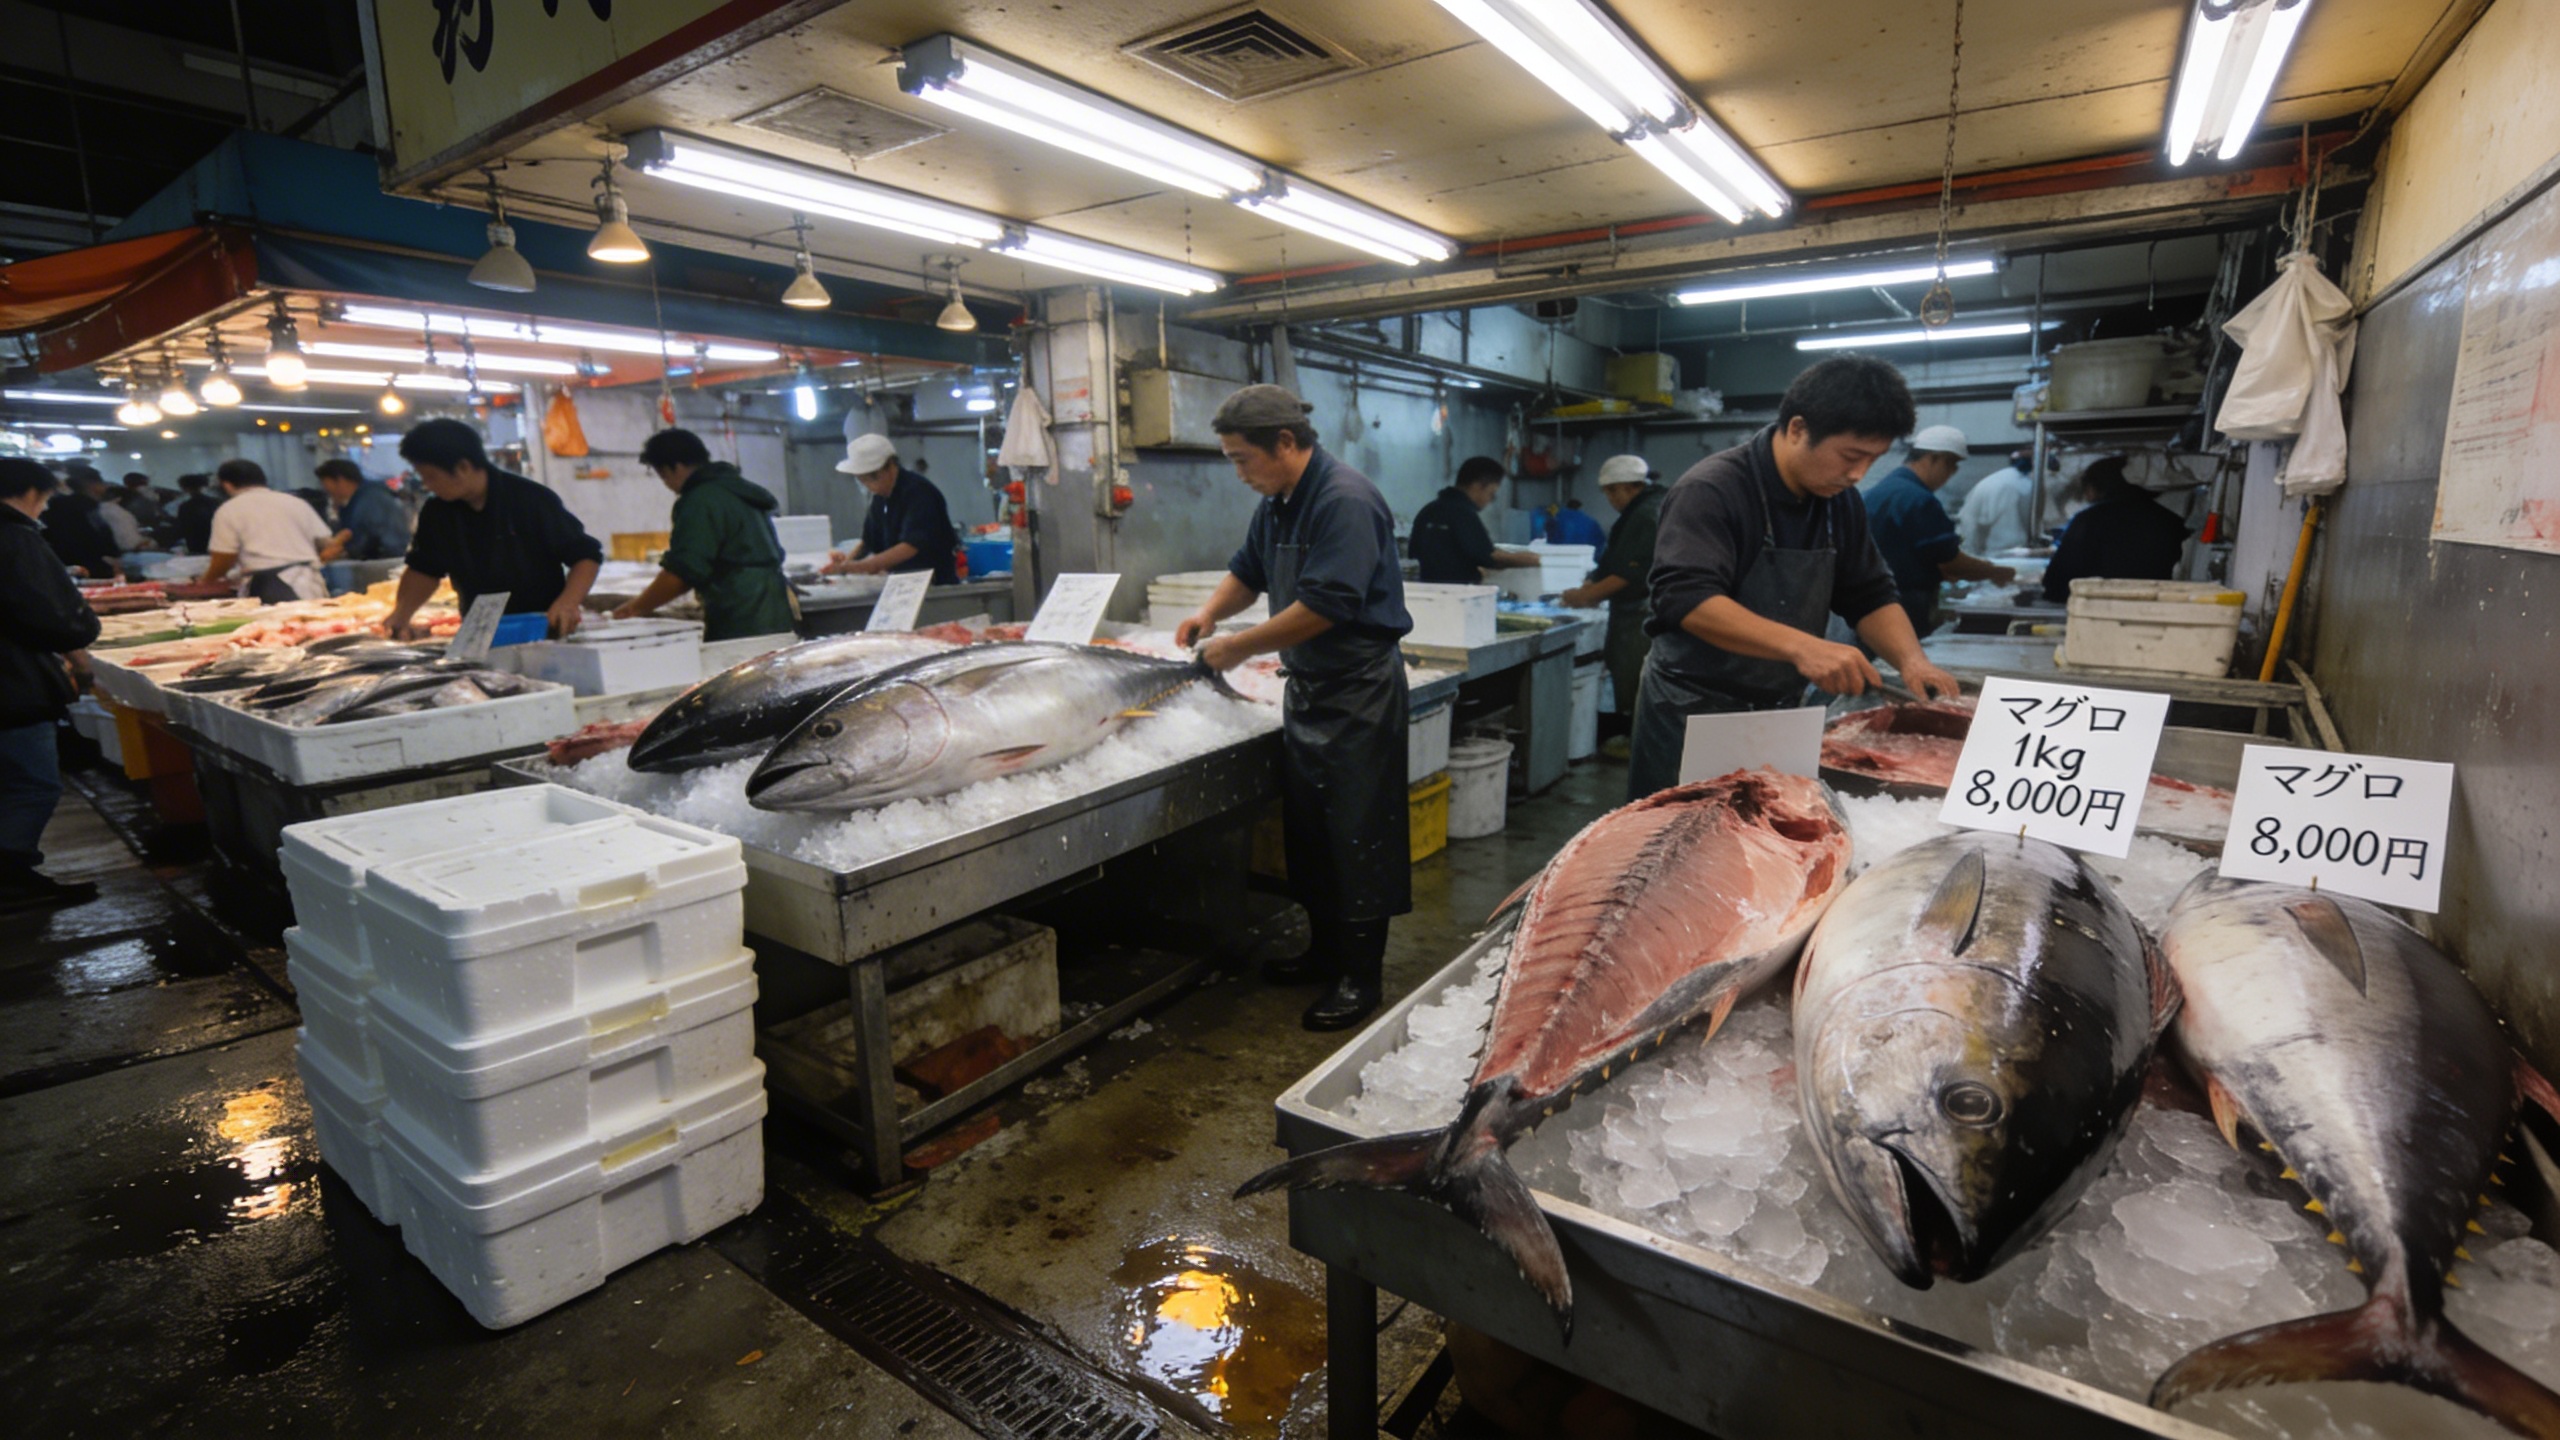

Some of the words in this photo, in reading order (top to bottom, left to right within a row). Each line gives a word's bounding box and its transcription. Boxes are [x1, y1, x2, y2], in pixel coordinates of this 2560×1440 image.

[2000, 695, 2127, 732] マグロ
[2014, 732, 2086, 781] 1kg
[2264, 762, 2404, 799] マグロ
[1966, 769, 2125, 831] 8,000円
[2250, 816, 2429, 882] 8,000円
